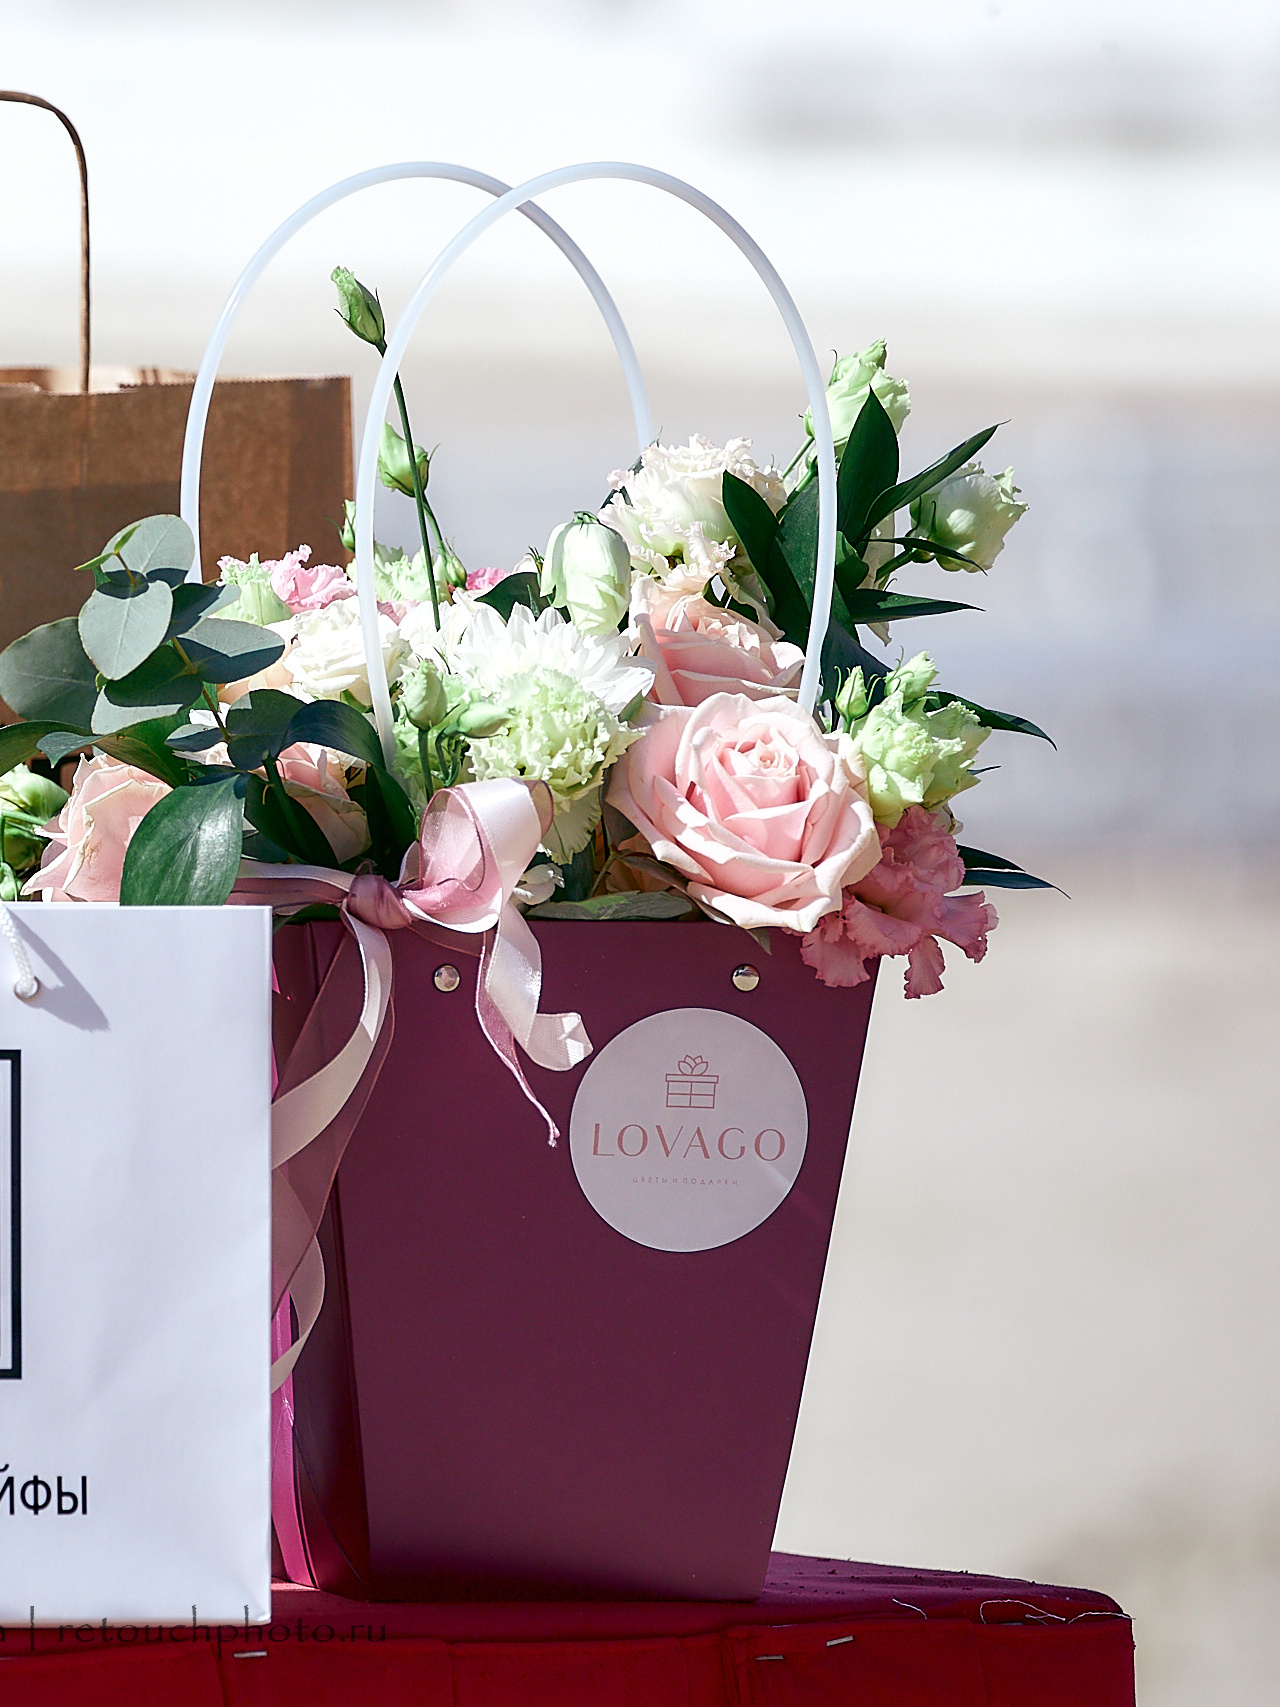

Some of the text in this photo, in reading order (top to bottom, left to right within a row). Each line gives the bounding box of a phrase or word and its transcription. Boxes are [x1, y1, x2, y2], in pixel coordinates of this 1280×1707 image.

[592, 1123, 786, 1162] LOVAGO
[632, 1176, 668, 1184] ЦВЕТЫ
[682, 1177, 738, 1186] ПОДАРКИ
